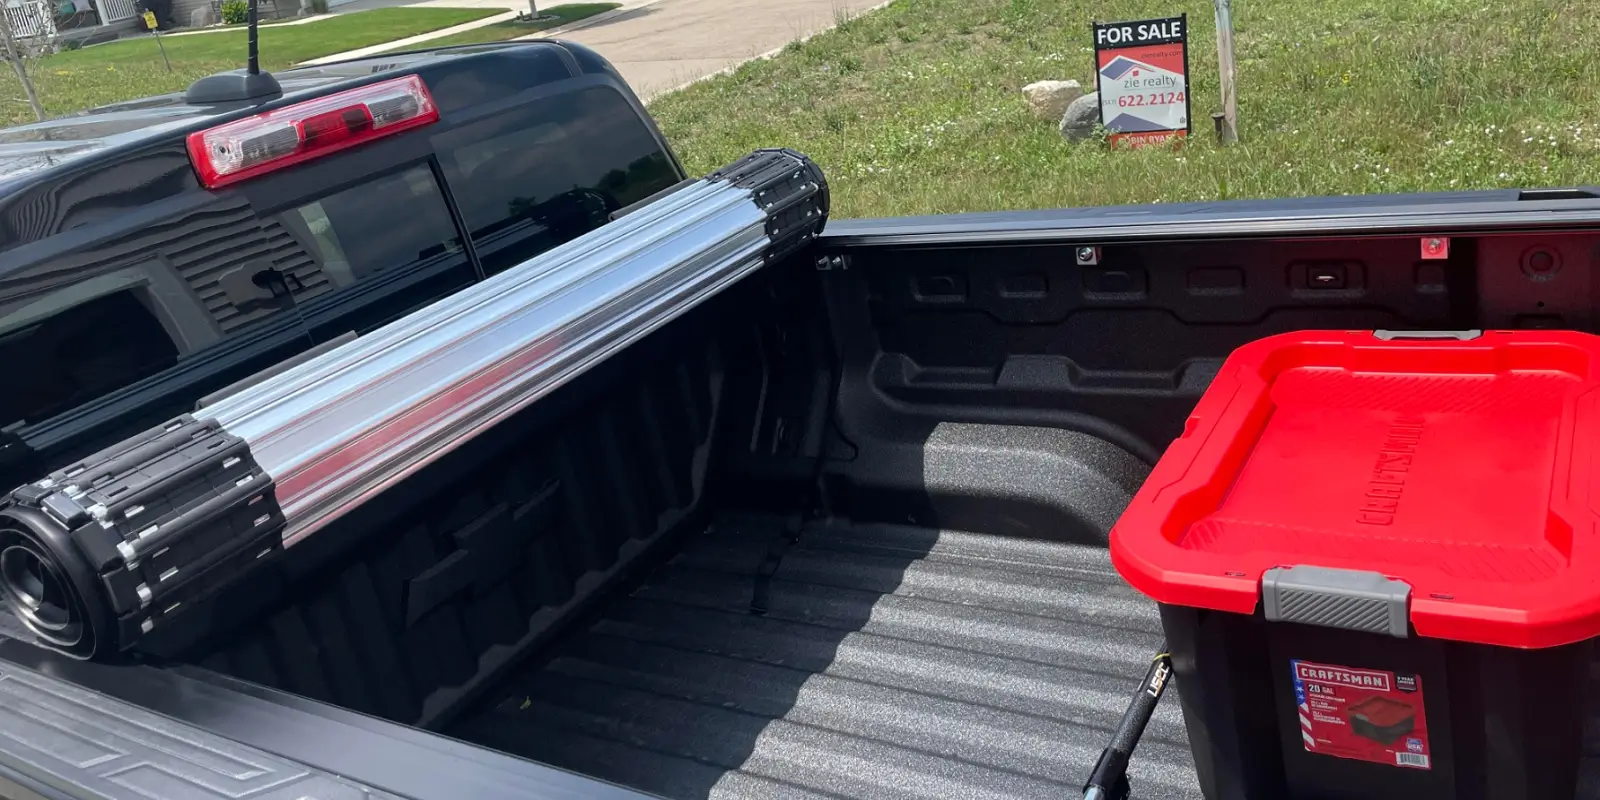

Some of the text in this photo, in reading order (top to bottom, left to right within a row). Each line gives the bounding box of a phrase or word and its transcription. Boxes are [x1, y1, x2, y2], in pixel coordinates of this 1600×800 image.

[1097, 21, 1182, 44] FOR SALE
[1124, 75, 1177, 88] zie realty
[1118, 91, 1185, 107] 622.2124
[1301, 667, 1383, 687] CRAFTSMAN
[1308, 684, 1321, 693] 20
